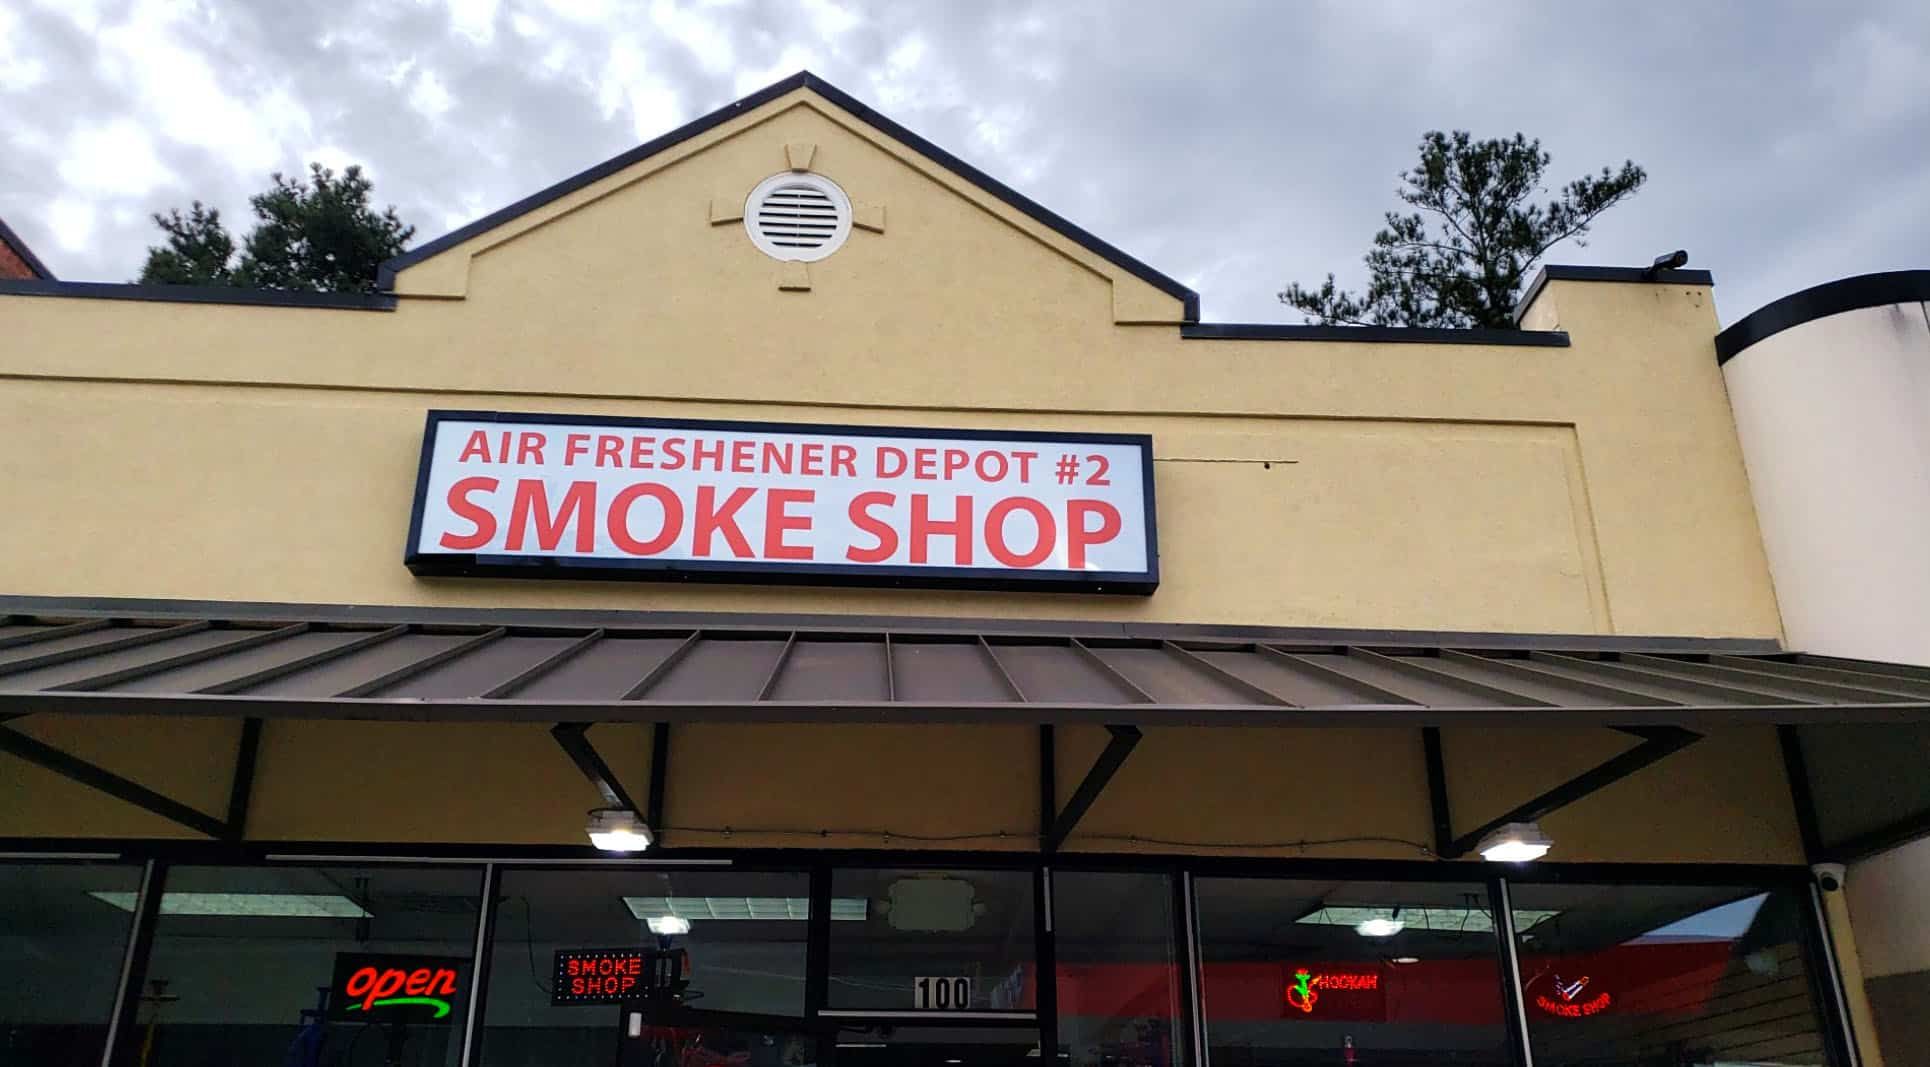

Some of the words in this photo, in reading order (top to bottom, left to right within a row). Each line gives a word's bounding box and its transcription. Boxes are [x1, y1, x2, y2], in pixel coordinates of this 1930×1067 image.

[459, 429, 547, 466] AIR
[564, 433, 858, 478] FRESHENER
[876, 446, 1039, 484] DEPOT
[1055, 453, 1111, 486] #2
[439, 477, 816, 561] SMOKE
[846, 491, 1122, 569] SHOP
[567, 957, 642, 976] SMOKE
[346, 966, 457, 1011] open
[571, 977, 637, 994] SHOP
[917, 977, 969, 1009] 100
[1318, 974, 1378, 990] HOOKAH
[1536, 994, 1582, 1017] SMOKE
[1583, 992, 1612, 1016] SHOP
